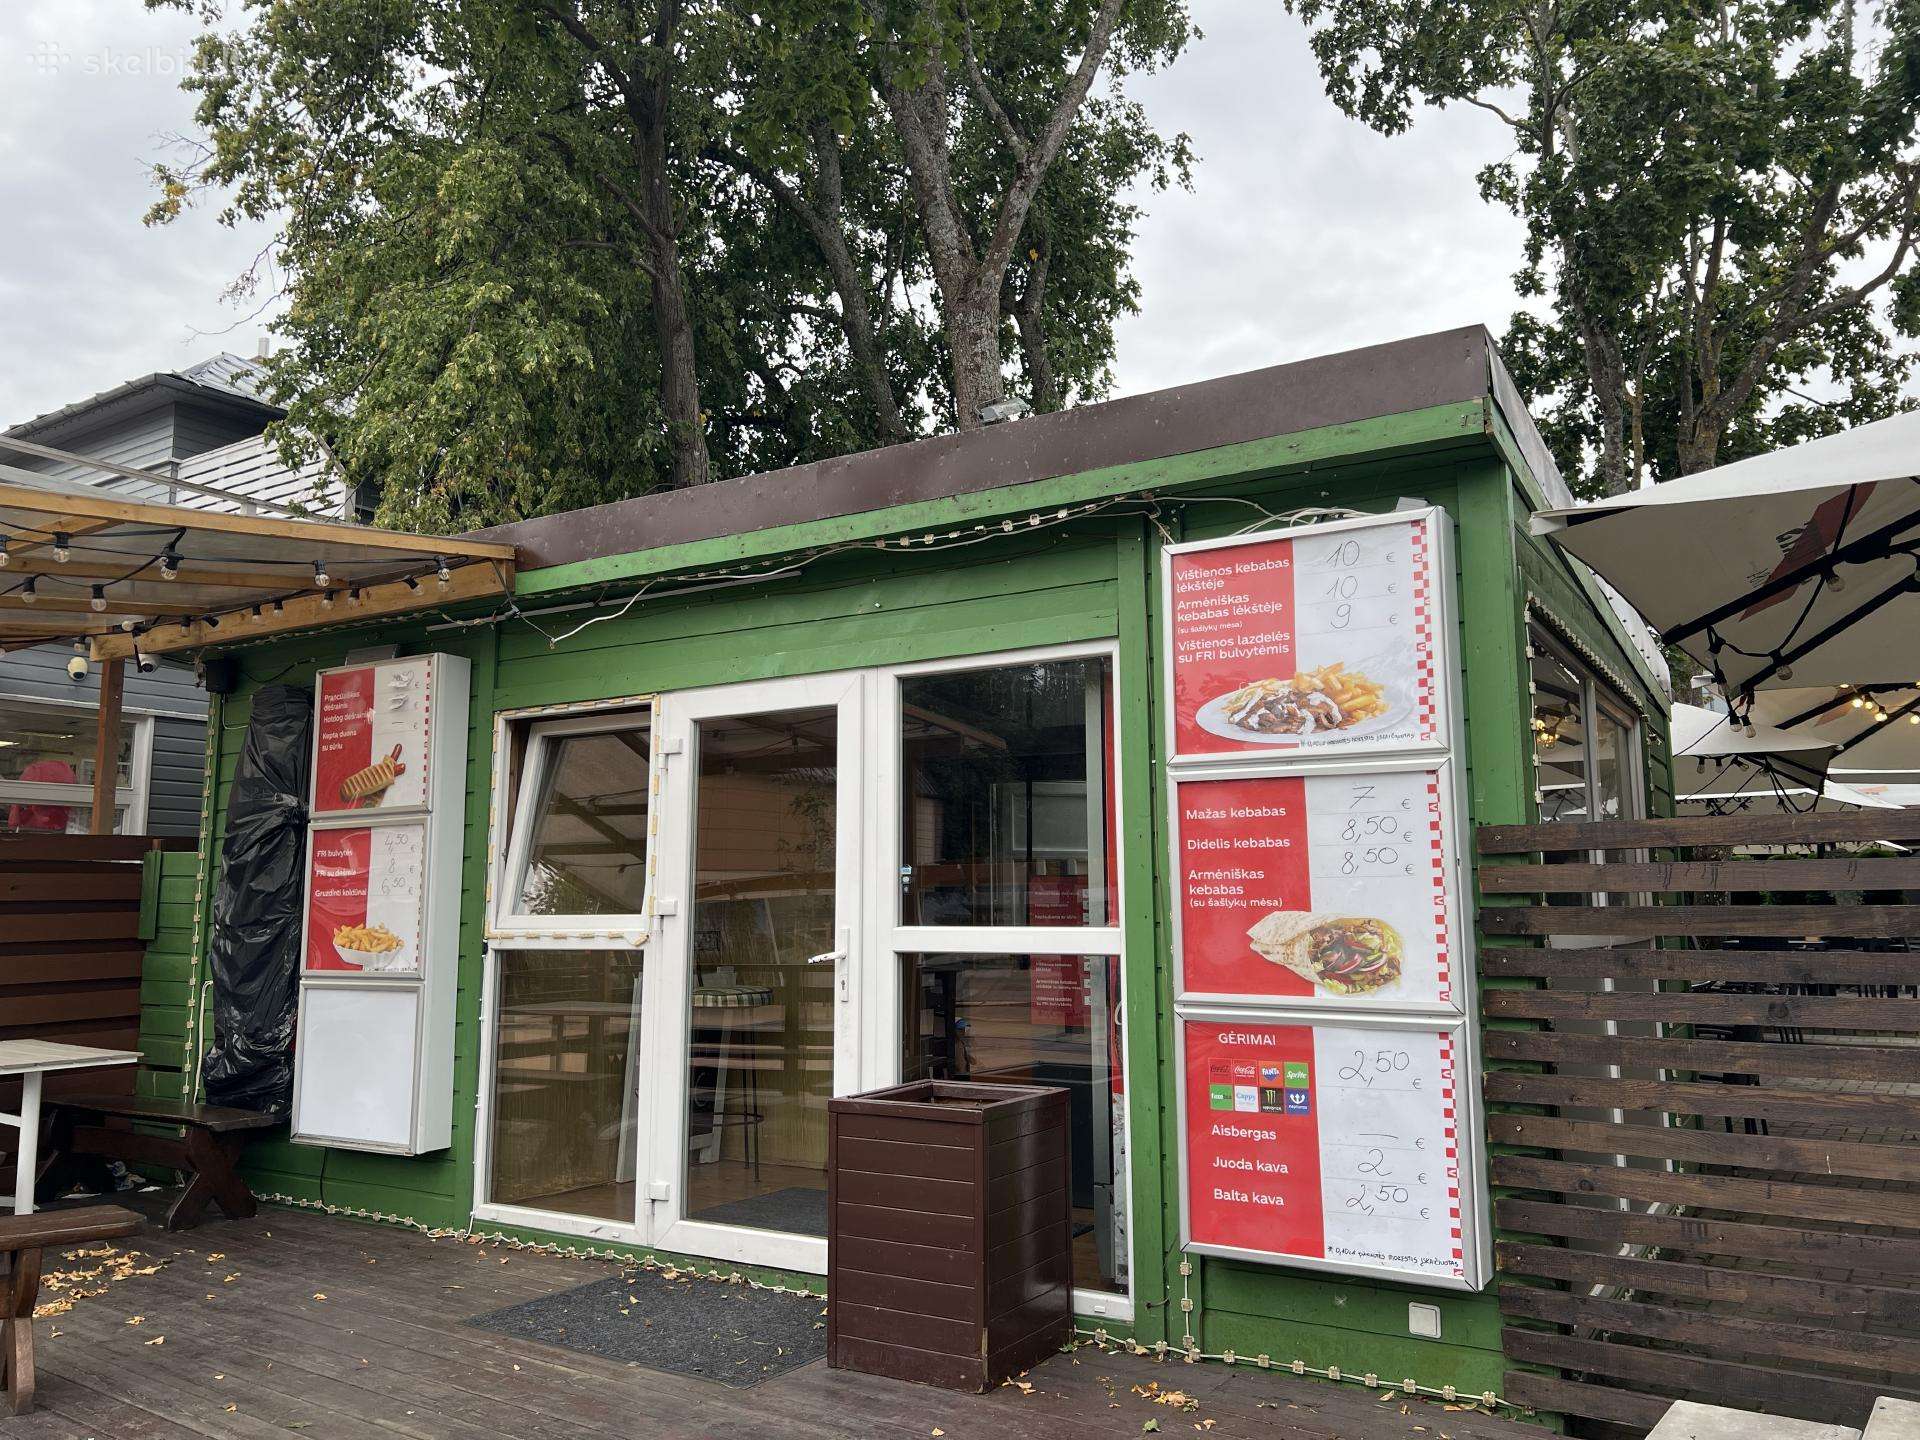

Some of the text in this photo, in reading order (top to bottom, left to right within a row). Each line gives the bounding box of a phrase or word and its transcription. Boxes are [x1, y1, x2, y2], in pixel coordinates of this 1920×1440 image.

[1326, 540, 1397, 567] 10 €
[1176, 558, 1290, 581] Vištienos kebabas
[1176, 578, 1225, 593] lėkštėje
[1326, 575, 1397, 599] 10 €
[1177, 594, 1250, 610] Armėniškas
[1177, 601, 1283, 623] kebabas lėkštėje
[1389, 614, 1397, 625] €
[1177, 630, 1290, 652] Vištienos lazdelės
[1178, 643, 1290, 664] su FRI bulvytėmis
[1350, 786, 1412, 810] 7 €
[1186, 806, 1286, 820] Mažas kebabas
[1341, 815, 1413, 843] 8,50 €
[1187, 836, 1291, 850] Didelis kebabas
[1341, 847, 1415, 875] 8,50 €
[1188, 868, 1265, 881] Armėniškas
[1189, 883, 1244, 895] kebabas
[1189, 897, 1283, 909] (su šašlykų mėsa)
[1218, 1030, 1276, 1046] GĖRIMAI
[1338, 1050, 1422, 1090] 2,50 €
[1211, 1125, 1277, 1141] Aisbergas
[1415, 1137, 1426, 1149] €
[1212, 1156, 1289, 1174] Juoda kava
[1357, 1148, 1427, 1184] 2 €
[1214, 1188, 1285, 1206] Balta kava
[1346, 1184, 1430, 1219] 2,50 €
